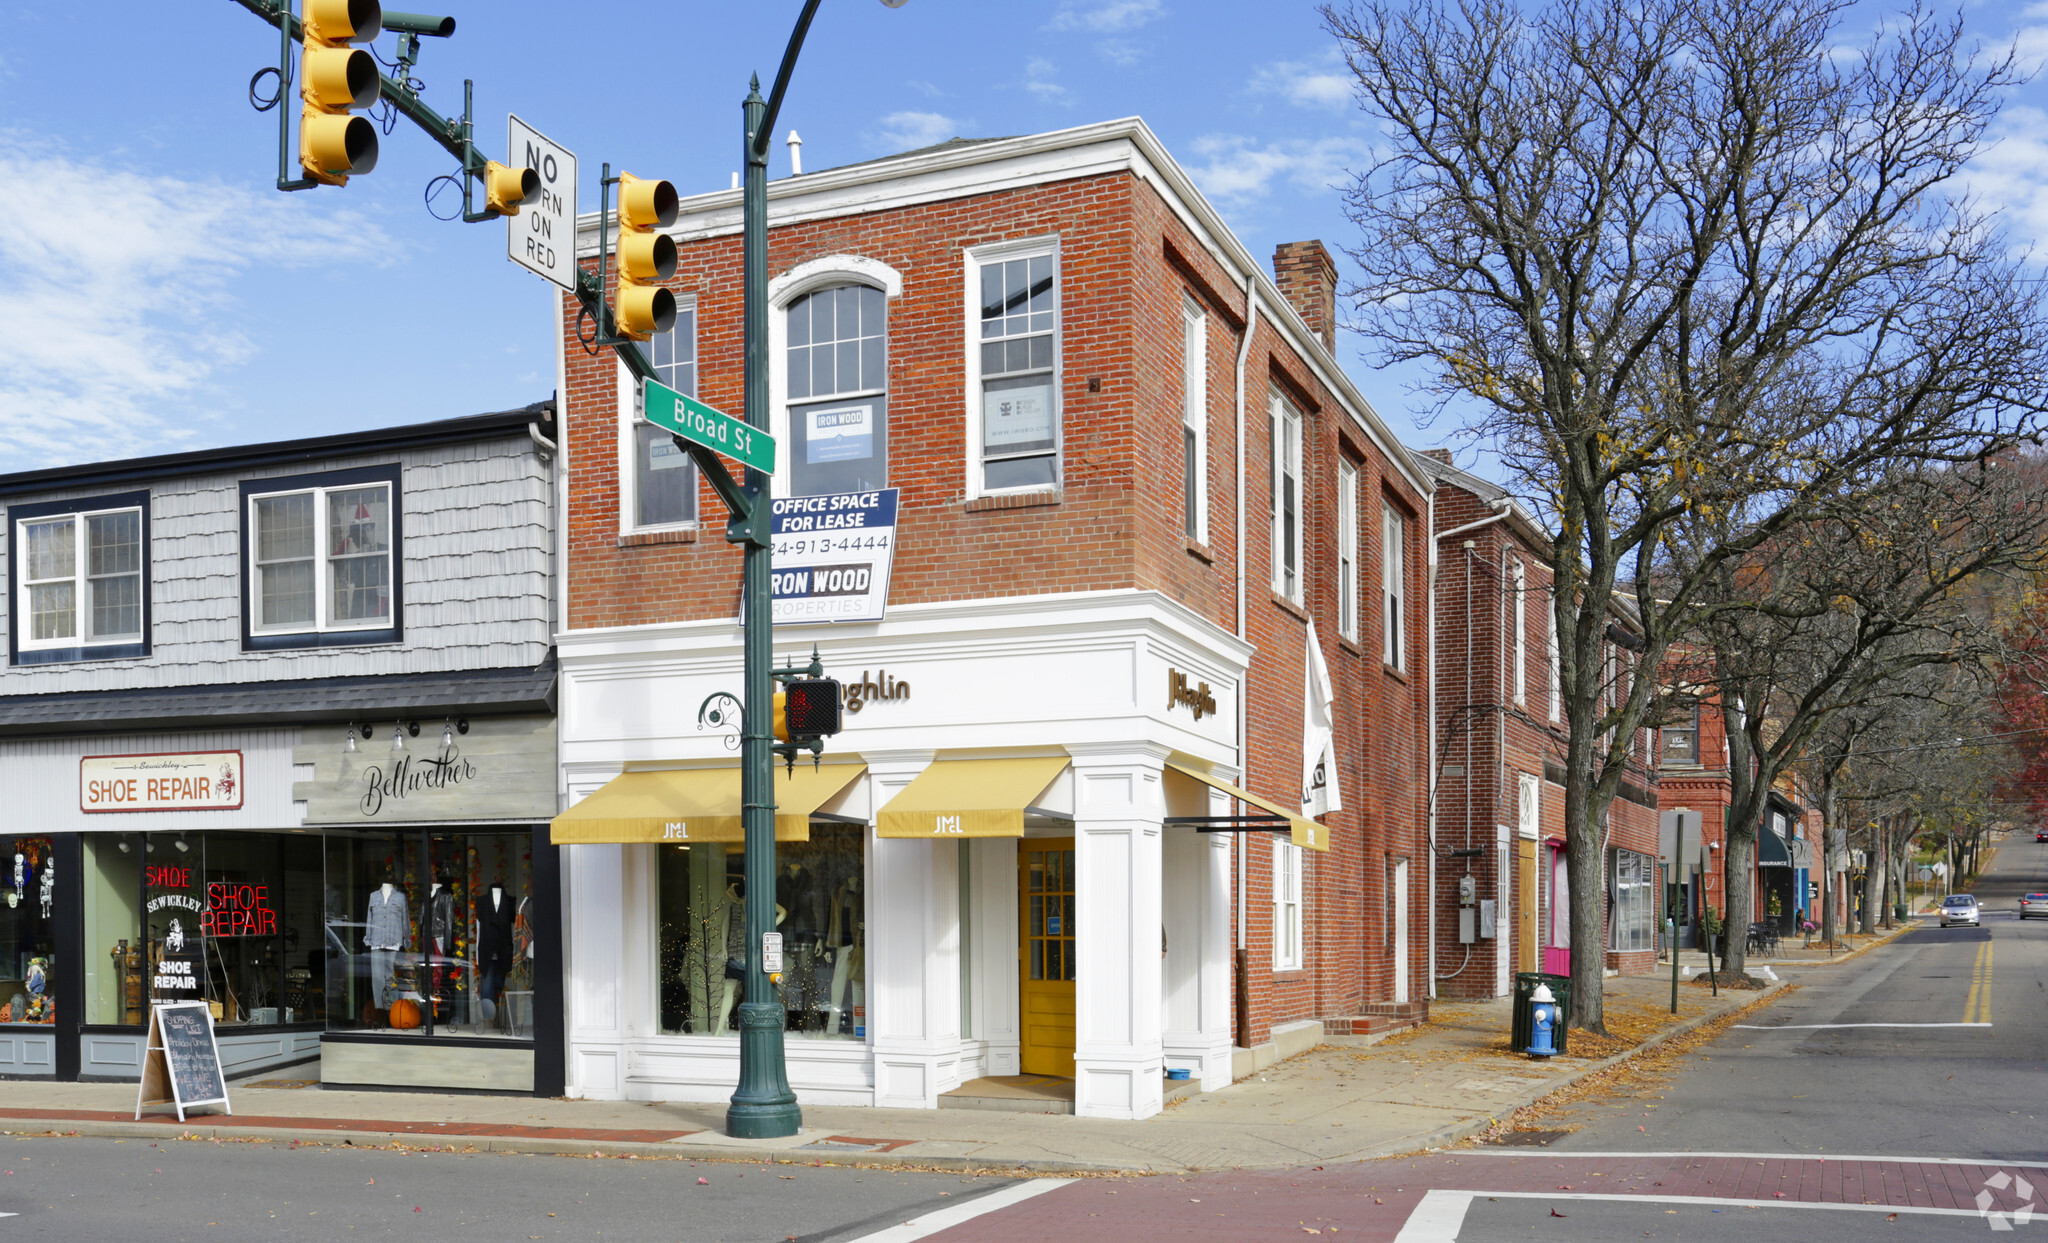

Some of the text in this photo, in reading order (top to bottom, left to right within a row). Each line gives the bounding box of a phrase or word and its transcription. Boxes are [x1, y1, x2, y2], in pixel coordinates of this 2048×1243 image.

[526, 139, 557, 184] NO
[542, 187, 562, 217] RN
[531, 211, 551, 240] ON
[526, 236, 555, 270] RED
[674, 398, 752, 455] Broad St
[818, 412, 862, 426] IRON WOOD
[772, 492, 880, 514] OFFICE SPACE
[781, 512, 865, 532] FOR LEASE
[771, 535, 888, 557] 4-913-4444
[771, 568, 870, 595] RON WOOD
[772, 599, 863, 616] ROPERTIES
[138, 761, 180, 771] Sewickley
[88, 777, 210, 803] SHOE REPAIR
[360, 743, 476, 816] Bellwether
[146, 866, 192, 887] SHOE
[146, 894, 202, 913] SEWICKLEY
[208, 884, 268, 910] SHOE
[201, 910, 276, 937] REPAIR
[158, 961, 191, 974] SHOE
[154, 975, 197, 989] REPAIR
[166, 1015, 195, 1024] SHOPPING
[185, 1024, 201, 1032] LIST
